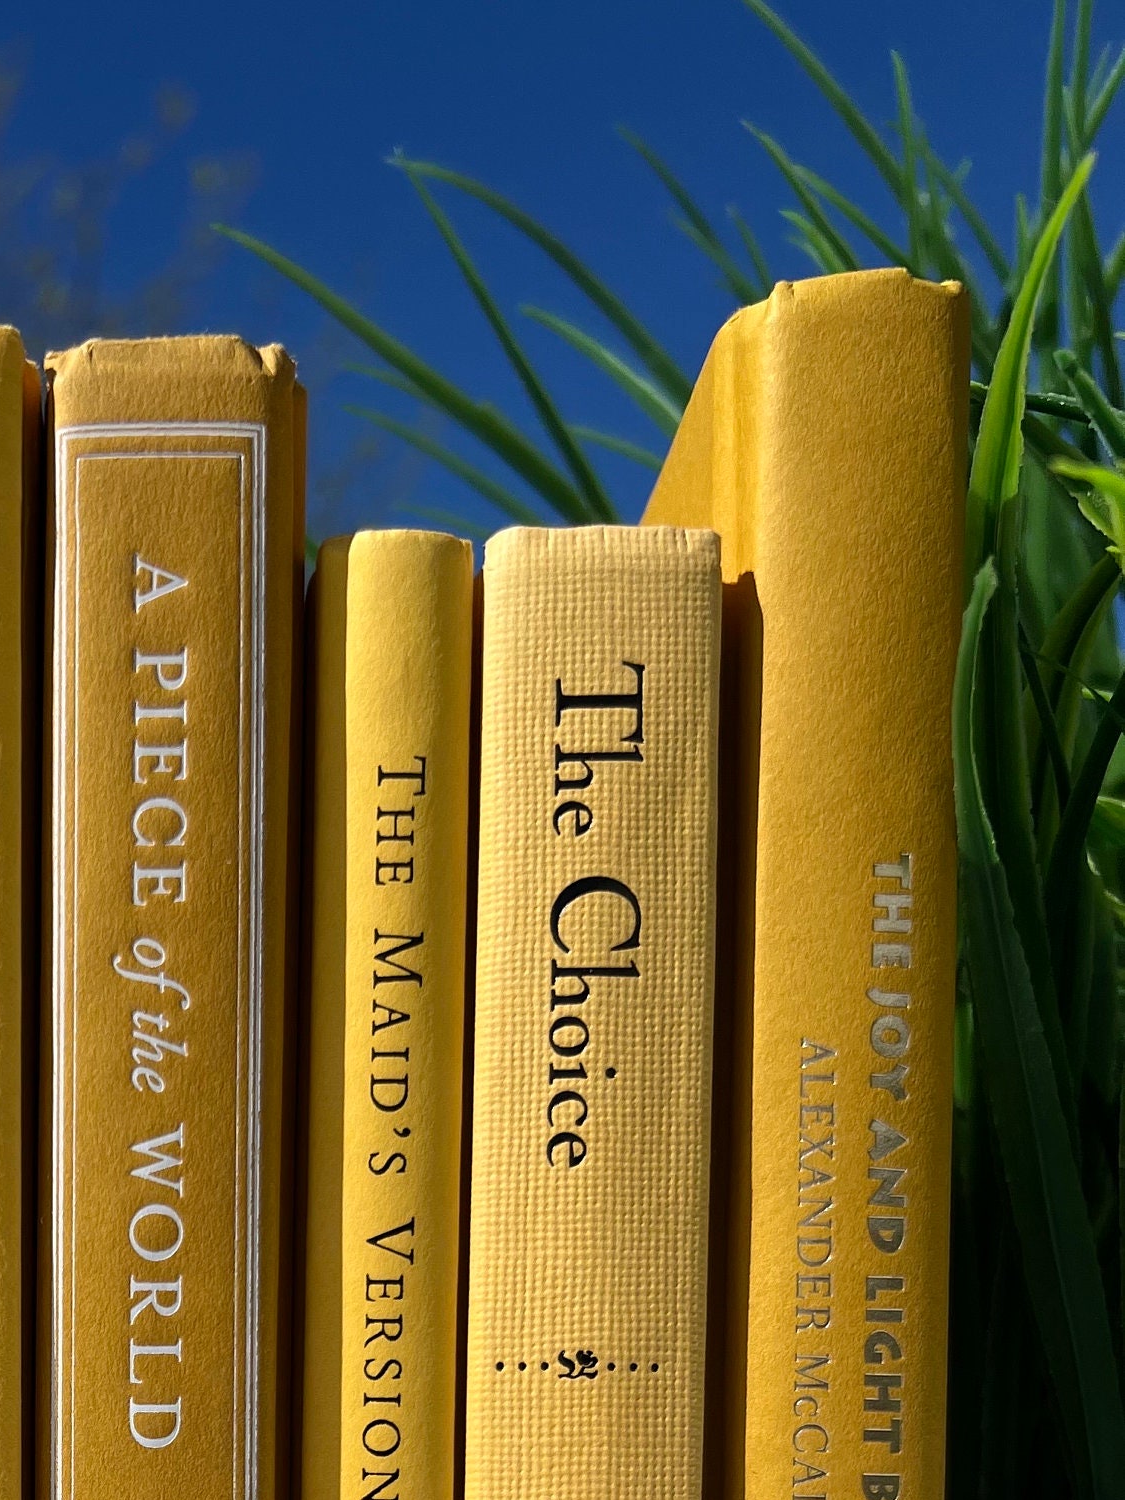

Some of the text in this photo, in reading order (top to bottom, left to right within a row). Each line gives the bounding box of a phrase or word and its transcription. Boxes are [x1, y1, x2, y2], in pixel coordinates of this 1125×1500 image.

[375, 755, 426, 887] THE
[545, 659, 646, 1169] The Choice
[870, 851, 913, 972] THE
[112, 553, 190, 1450] A PIECE of the WORLD
[867, 987, 911, 1101] JOY
[793, 1035, 838, 1335] ALEXANDER
[865, 1118, 910, 1254] AND
[859, 1274, 905, 1455] LIGHT
